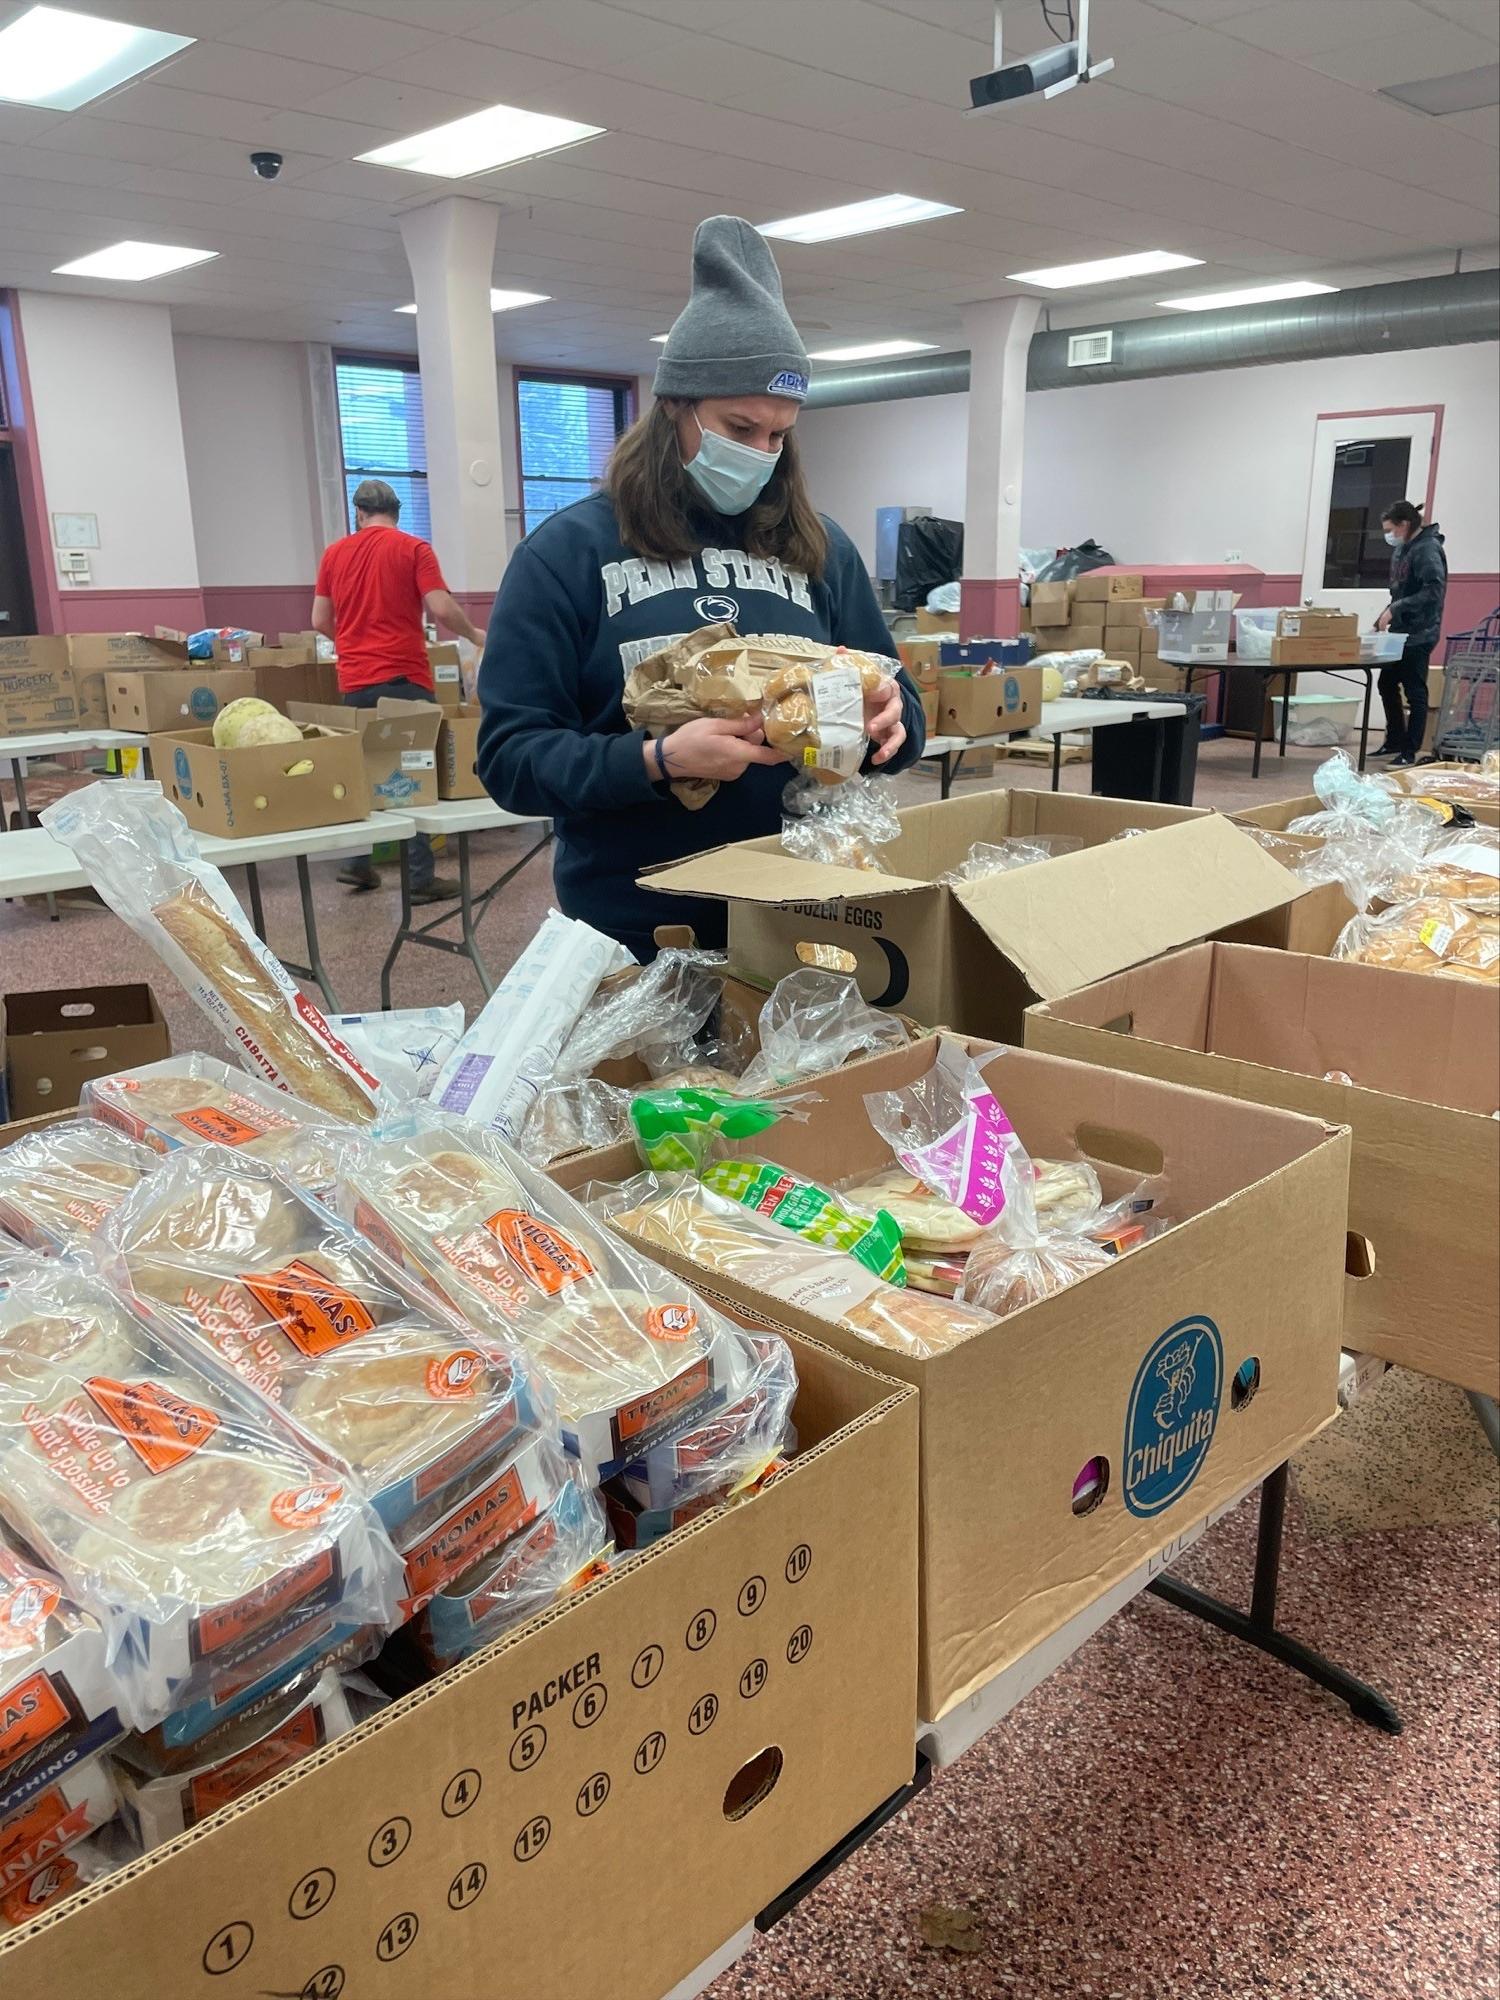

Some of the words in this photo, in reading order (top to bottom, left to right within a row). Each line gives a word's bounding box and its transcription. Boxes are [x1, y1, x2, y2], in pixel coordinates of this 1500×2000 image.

[601, 556, 698, 618] PENN
[702, 548, 815, 614] STATE
[844, 906, 883, 931] EGGS
[235, 1026, 279, 1082] CIABATTA
[302, 1005, 337, 1047] TRADER
[788, 1197, 812, 1223] BREAD
[494, 1264, 515, 1289] up
[511, 1281, 530, 1305] to
[789, 1285, 810, 1302] TAKE
[185, 1286, 235, 1350] what's
[217, 1284, 262, 1341] Wake
[256, 1338, 282, 1366] up
[23, 1403, 69, 1459] what's
[64, 1400, 103, 1452] Wake
[90, 1448, 118, 1474] up
[107, 1467, 131, 1489] to
[623, 1408, 705, 1463] EVERYTHING
[1127, 1408, 1215, 1490] Chiquita
[511, 1652, 602, 1731] PACKER
[306, 1970, 337, 2000] 12
[382, 1917, 413, 1955] 13
[453, 1867, 481, 1902] 14
[519, 1823, 546, 1854] 15
[580, 1780, 605, 1808] 16
[638, 1737, 661, 1767] 17
[692, 1701, 714, 1728] 18
[743, 1666, 764, 1692] 19
[790, 1628, 809, 1658] 20
